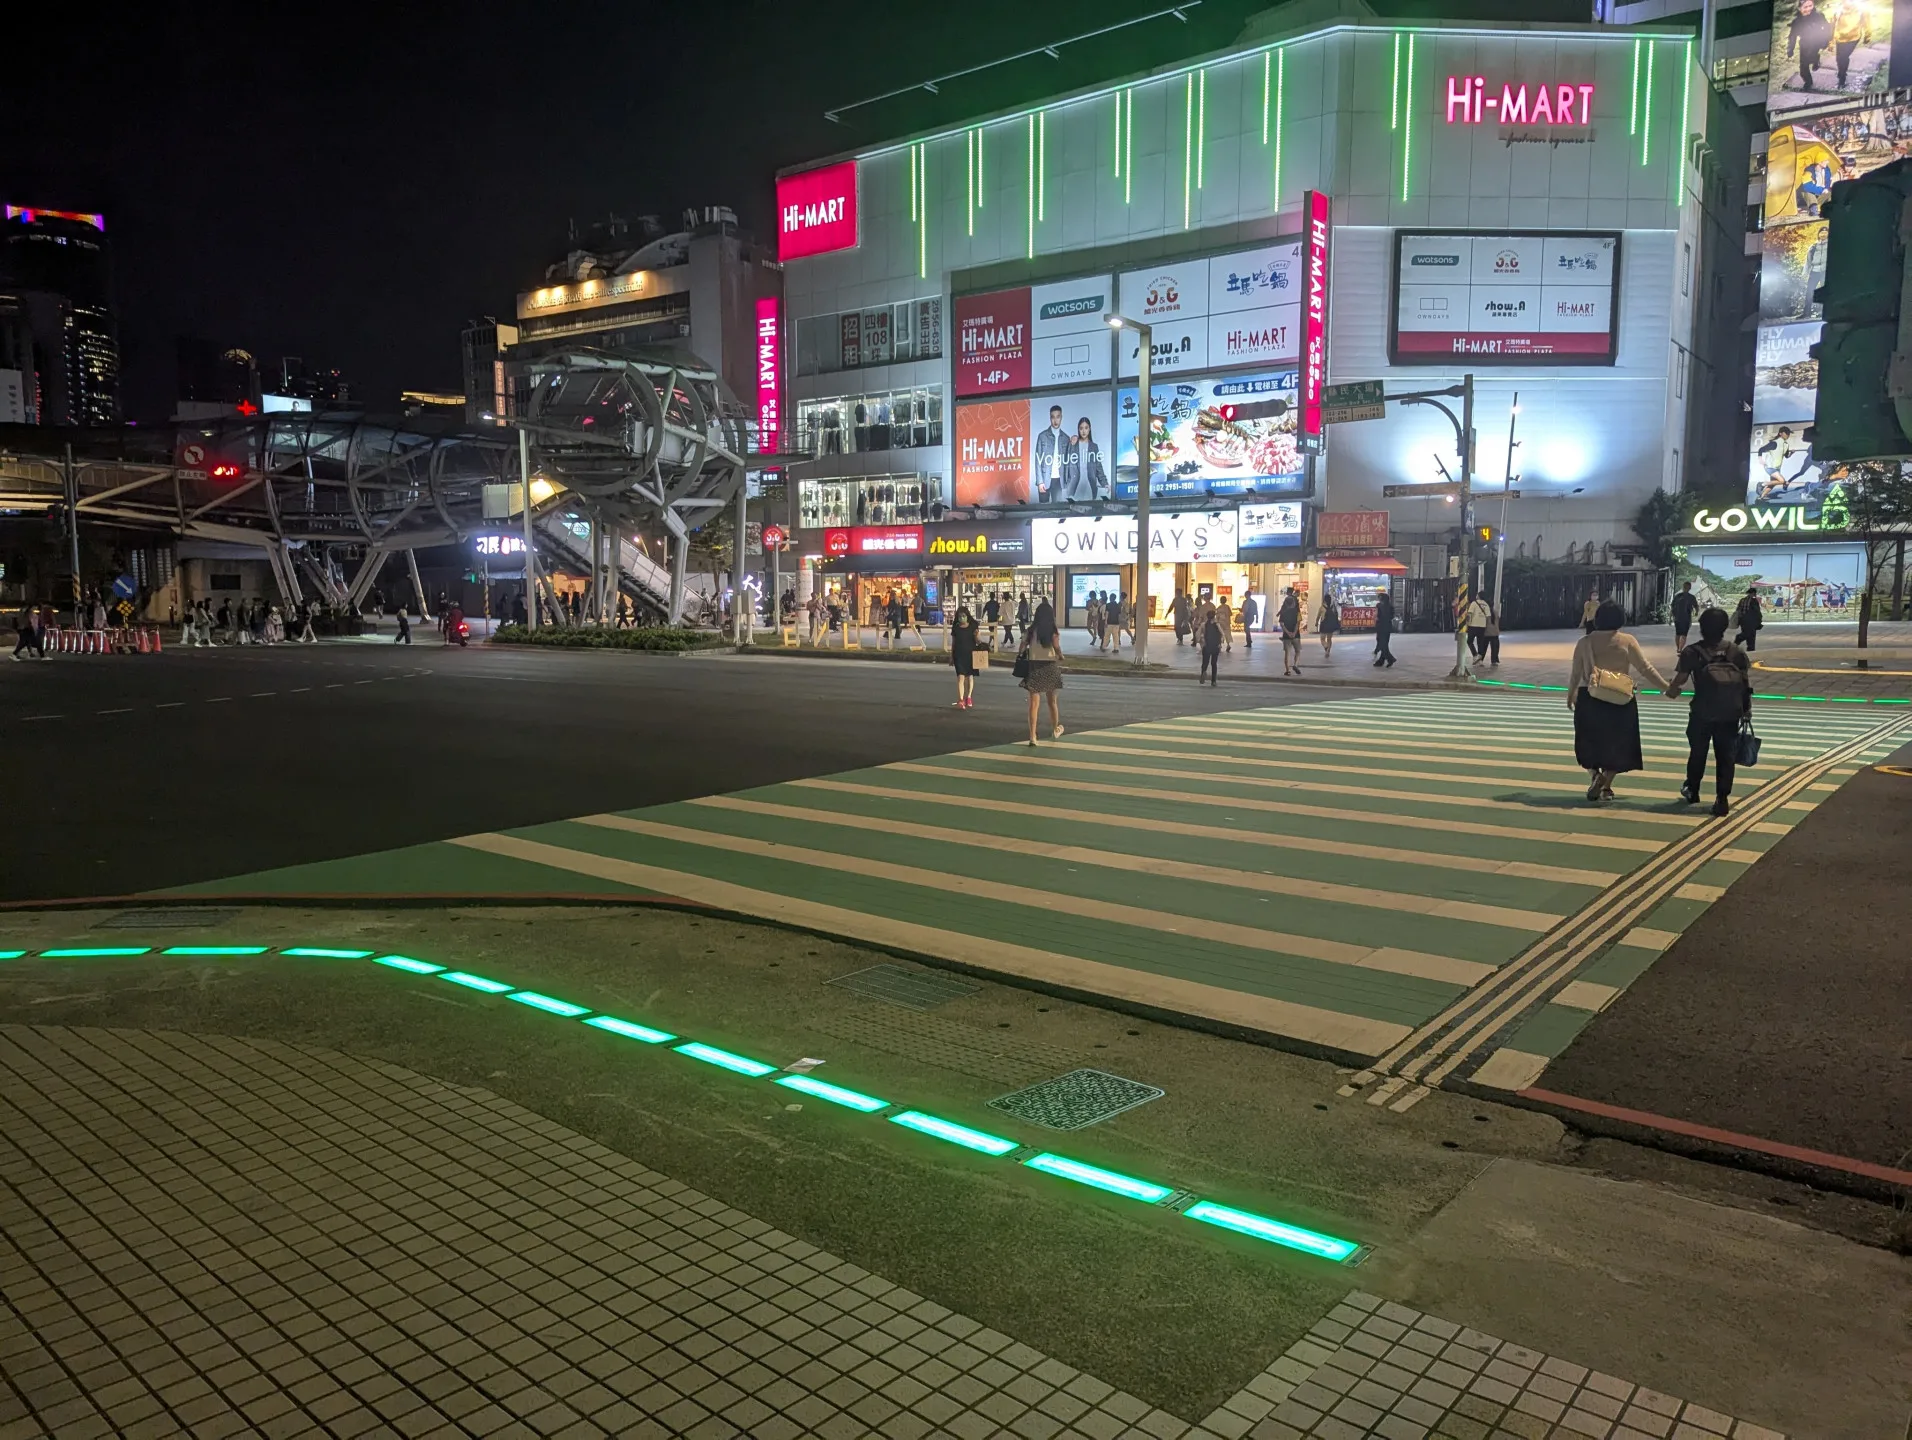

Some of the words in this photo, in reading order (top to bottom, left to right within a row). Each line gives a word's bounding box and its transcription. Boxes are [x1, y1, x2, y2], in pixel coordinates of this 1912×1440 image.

[1446, 77, 1595, 125] Hi-MART
[783, 196, 846, 233] Hi-MART
[1311, 219, 1325, 323] Hi-MART
[1047, 299, 1096, 315] watsons
[1557, 301, 1595, 313] Hi-MART
[865, 331, 888, 347] 108
[962, 324, 1024, 352] Hi-MART
[1227, 326, 1287, 351] Hi-MART
[1761, 327, 1785, 339] FLY
[759, 317, 776, 390] Hi-MART
[1227, 348, 1259, 356] FASHION
[1453, 338, 1503, 353] Hi-MART
[962, 354, 995, 365] FASHION
[999, 352, 1023, 361] PLAZA
[1760, 350, 1783, 361] FLY
[976, 370, 1002, 385] 1-4F
[1050, 368, 1092, 380] OWNDAYS
[1281, 375, 1299, 388] 4F
[962, 436, 1024, 461] Hi-MART
[1035, 451, 1079, 469] Vogue
[1082, 449, 1105, 463] line
[962, 465, 995, 473] FASHION
[999, 463, 1022, 471] PLAZA
[1693, 507, 1748, 533] GO
[1751, 505, 1850, 532] WILD
[1054, 527, 1208, 552] OWNDAYS
[1482, 528, 1489, 540] 4
[929, 535, 987, 554] show.A
